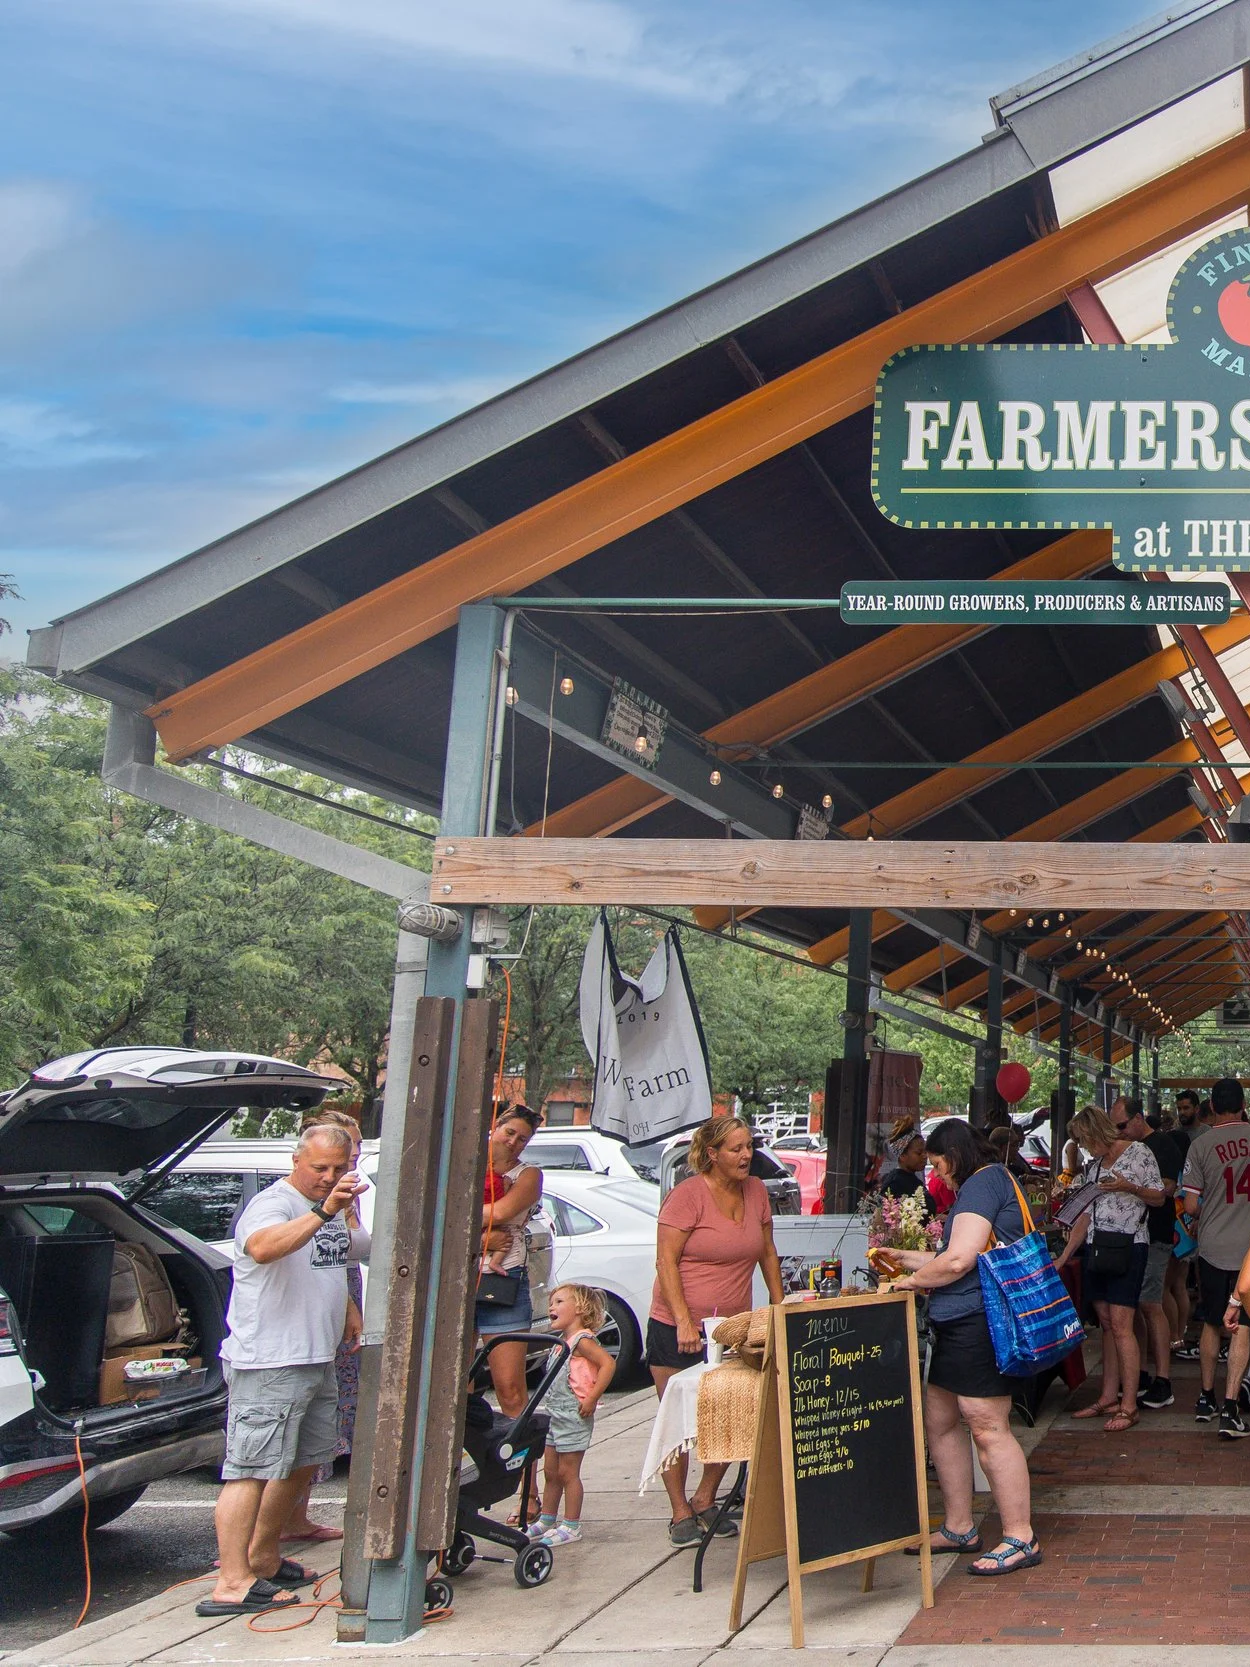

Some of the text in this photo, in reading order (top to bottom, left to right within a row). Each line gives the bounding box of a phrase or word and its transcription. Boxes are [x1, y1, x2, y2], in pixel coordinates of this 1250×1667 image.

[1134, 524, 1171, 558] at
[846, 594, 1225, 613] YEAR-ROUND GROWERS, PRODUCERS & ARTISANS
[617, 1011, 660, 1025] 2019
[623, 1067, 692, 1101] Farm
[793, 1348, 823, 1372] Floral
[796, 1441, 814, 1455] Quail
